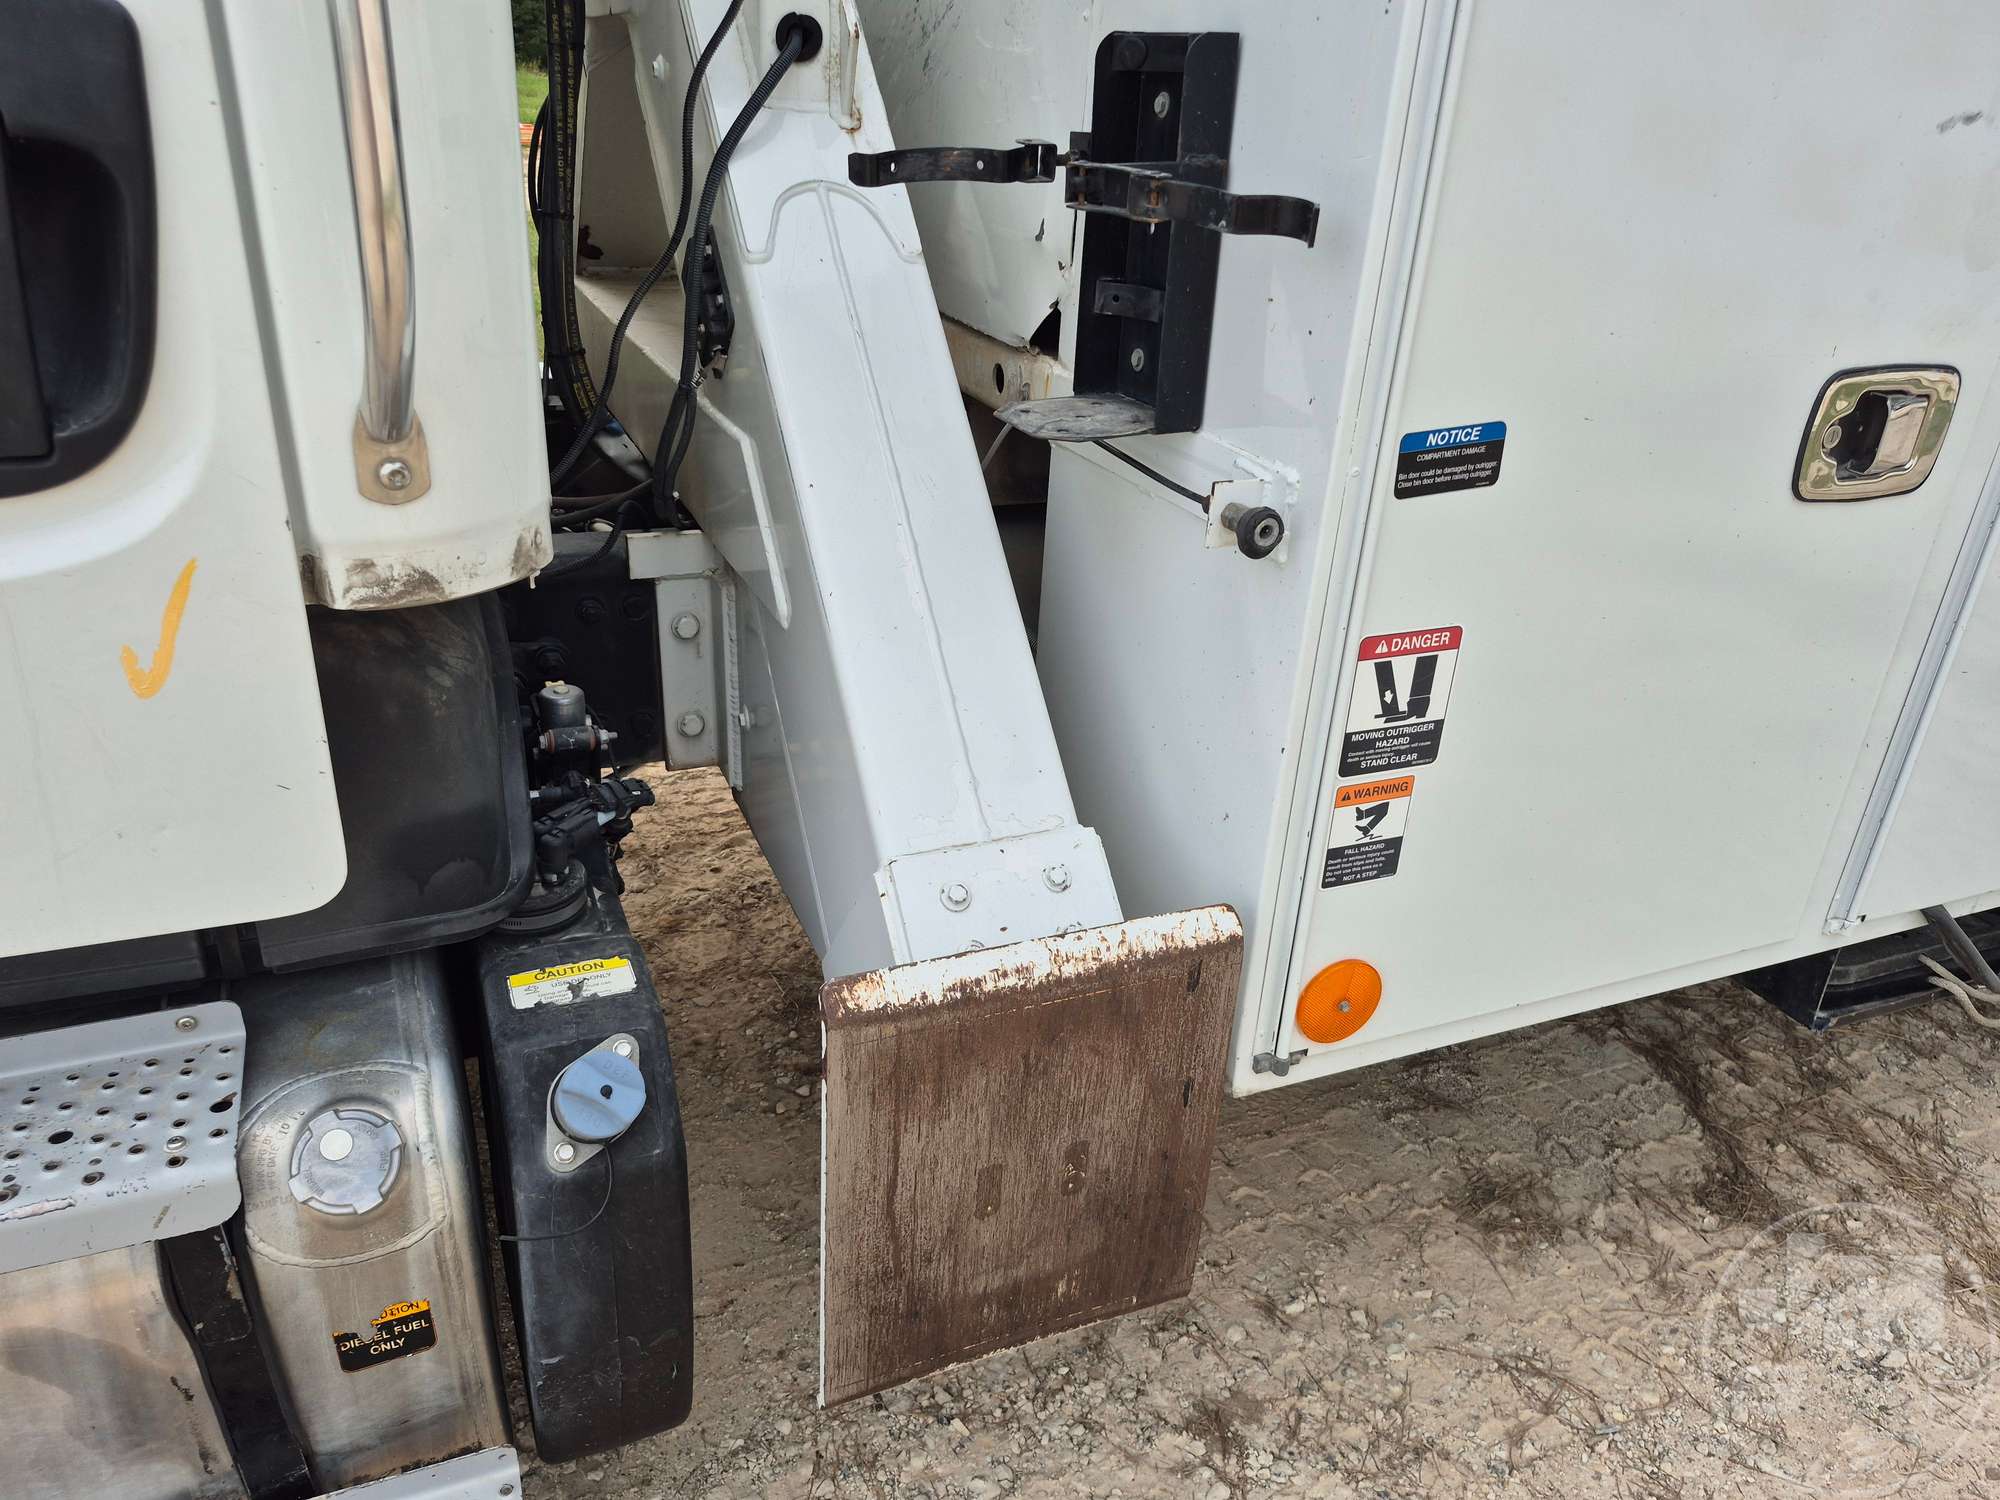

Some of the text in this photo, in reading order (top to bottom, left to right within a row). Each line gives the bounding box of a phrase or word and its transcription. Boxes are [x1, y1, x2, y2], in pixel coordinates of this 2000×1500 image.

[1426, 426, 1482, 447] NOTICE
[1416, 445, 1487, 462] COMPARTMENT DAMAGE
[1398, 473, 1408, 481] Bin
[1408, 471, 1421, 480] door
[1420, 469, 1435, 477] could
[1443, 464, 1468, 475] damaged
[1468, 463, 1475, 472] by
[1397, 481, 1413, 489] Close
[1422, 477, 1434, 485] door
[1434, 475, 1452, 484] before
[1452, 473, 1469, 482] raising
[1391, 632, 1450, 652] DANGER
[1351, 722, 1435, 742] MOVING OUTRIGGER
[1375, 736, 1410, 749] HAZARD
[1360, 757, 1389, 769] STAND
[1389, 753, 1418, 764] CLEAR
[1353, 781, 1409, 799] WARNING
[1344, 842, 1385, 855] FALL HAZARD
[1342, 873, 1356, 882] NOT
[1355, 872, 1361, 880] A
[1361, 869, 1378, 879] STEP
[534, 960, 605, 981] CAUTION
[393, 1319, 430, 1335] FUEL
[369, 1337, 406, 1355] ONLY
